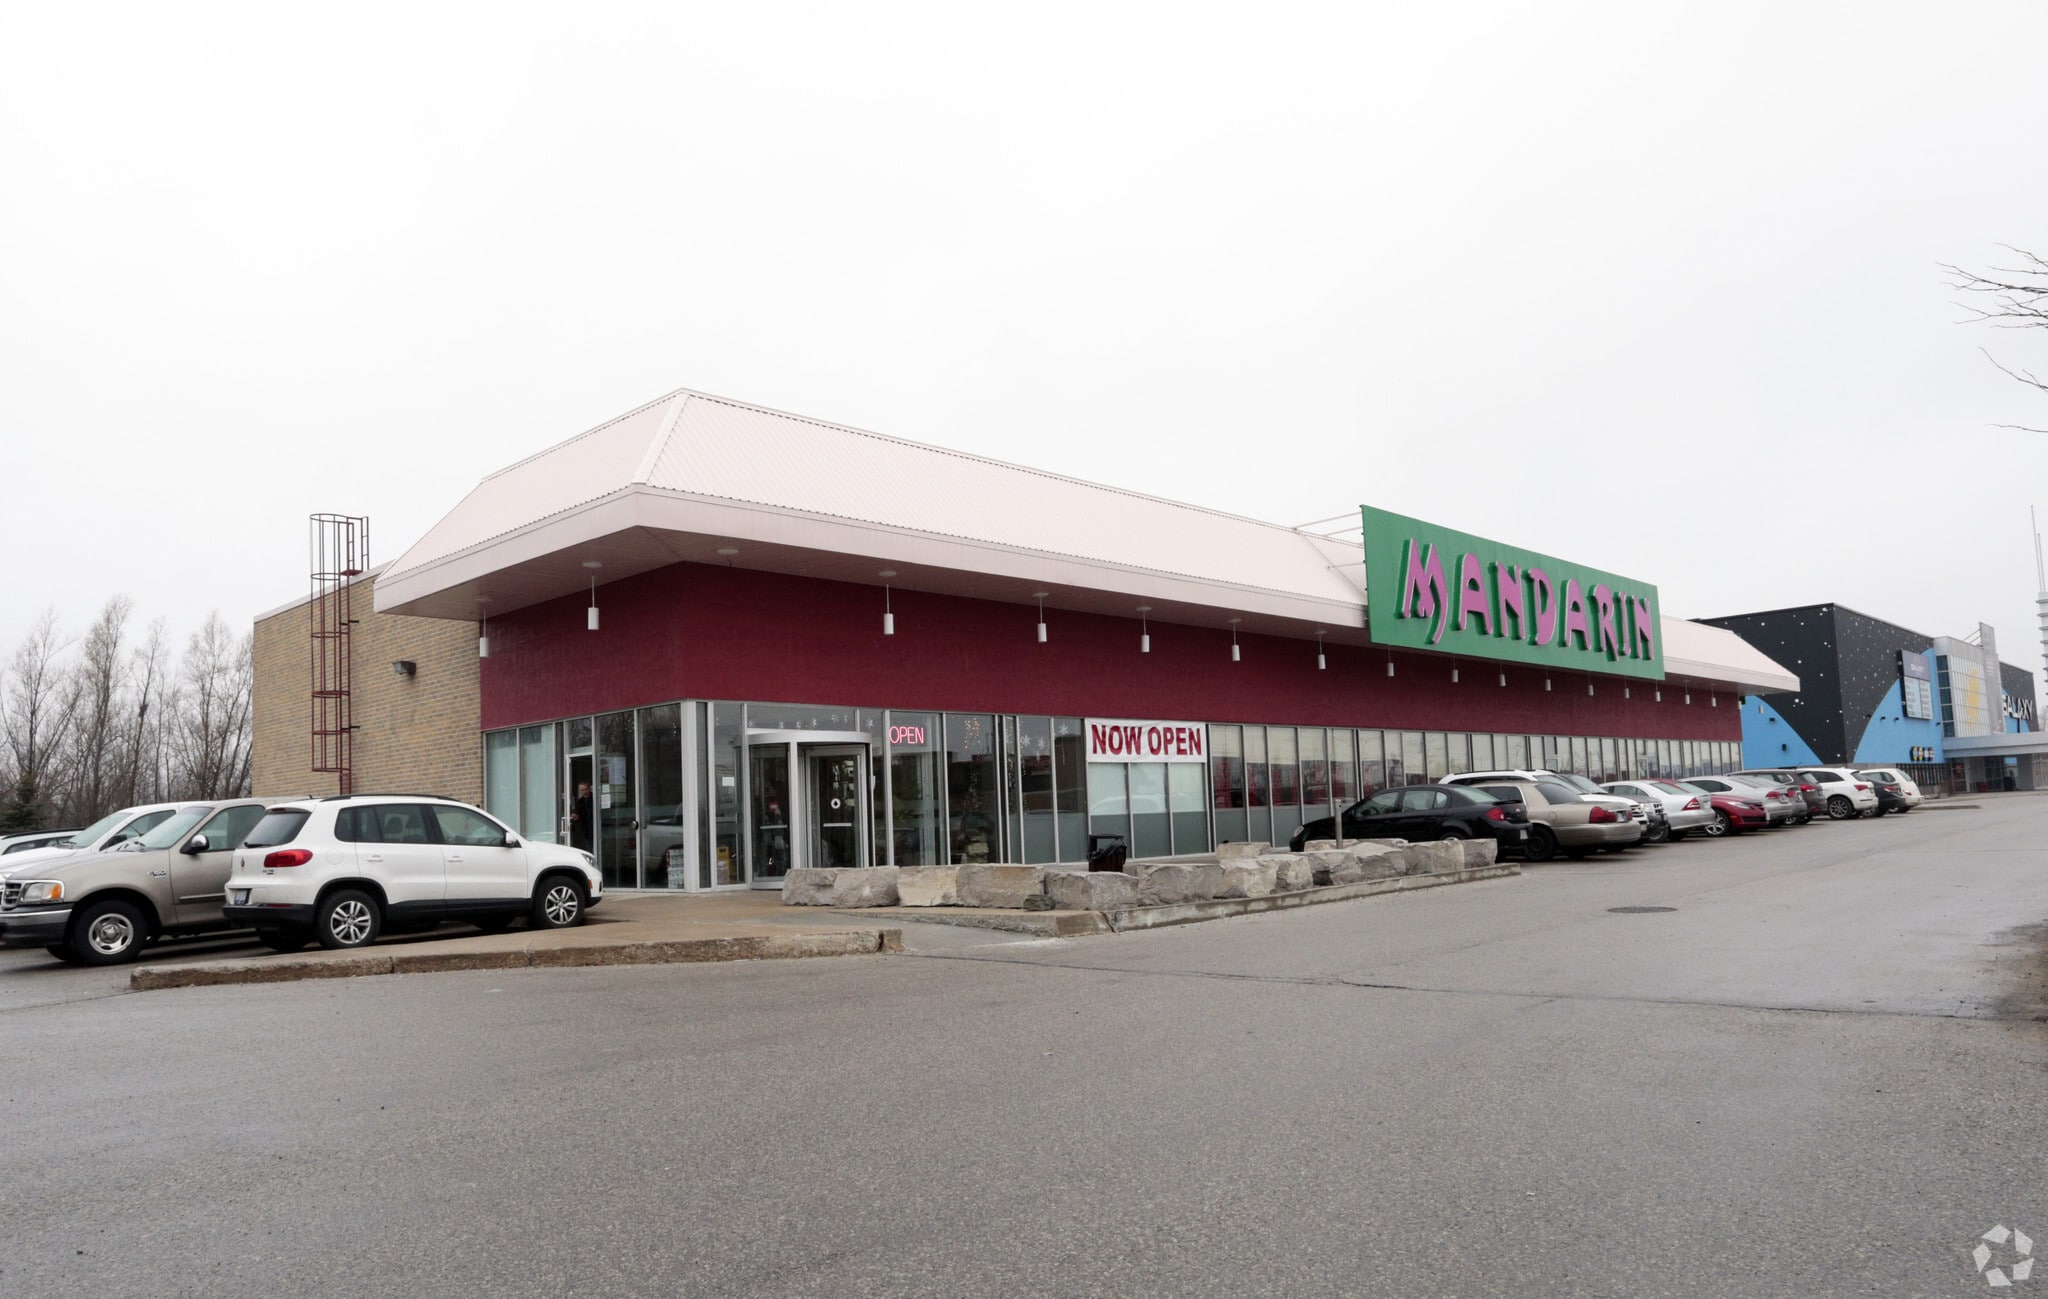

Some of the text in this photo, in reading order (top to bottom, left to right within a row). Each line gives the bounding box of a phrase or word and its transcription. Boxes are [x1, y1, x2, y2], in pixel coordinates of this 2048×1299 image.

[1396, 538, 1655, 661] MANDARIN
[889, 725, 924, 744] OPEN
[1091, 724, 1202, 755] NOW OPEN
